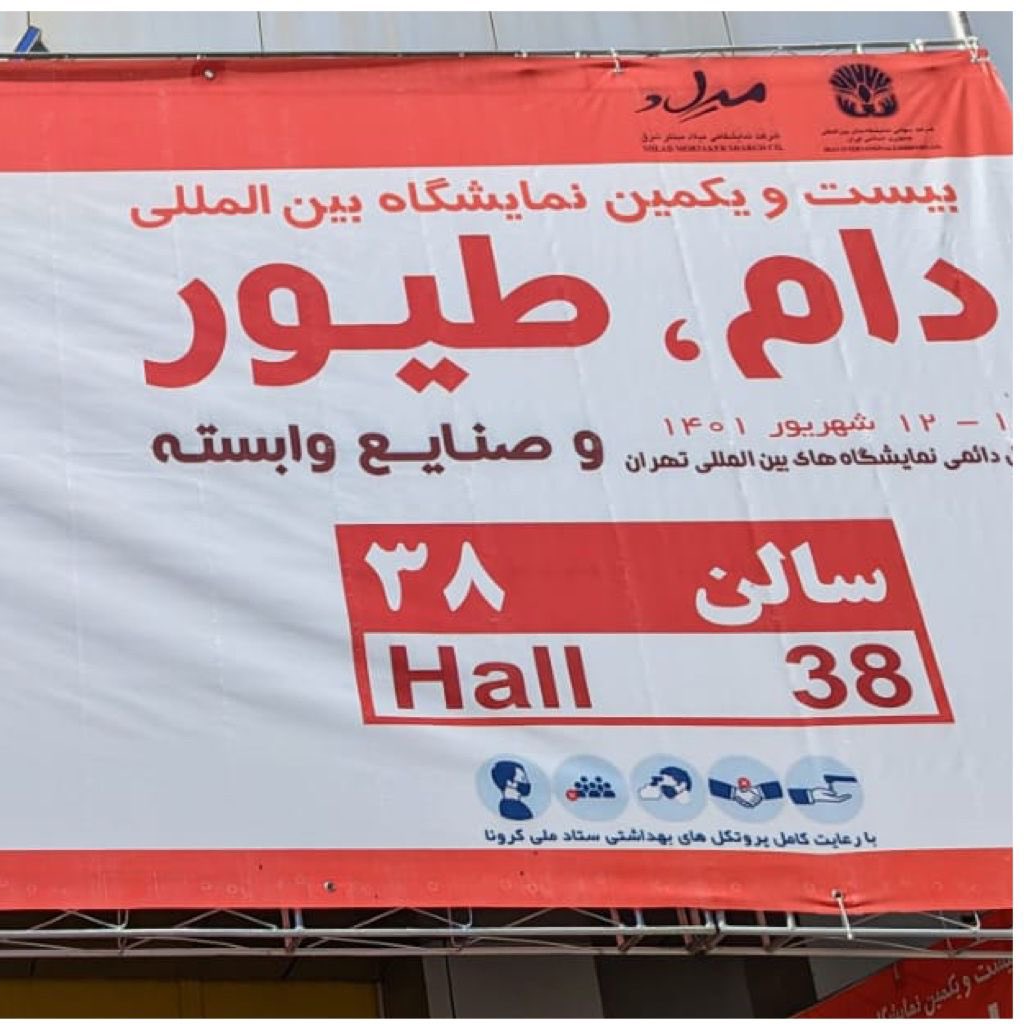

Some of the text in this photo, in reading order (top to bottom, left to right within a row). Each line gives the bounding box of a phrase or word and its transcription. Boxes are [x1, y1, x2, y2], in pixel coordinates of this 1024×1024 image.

[130, 176, 959, 232] بیست و یکمین نمایشگاه بین المللی
[144, 234, 613, 394] طیور
[663, 416, 746, 436] ۱۴۰۱
[768, 412, 876, 438] شهریور
[153, 424, 605, 477] و صنایع وابسته
[840, 445, 938, 472] نمایشگاه
[944, 446, 1002, 472] دائمی
[626, 452, 690, 474] تهران
[696, 452, 756, 475] المللی
[760, 454, 790, 473] بین
[365, 542, 888, 627] سالن ۳۸
[390, 643, 914, 712] Hall 38
[485, 829, 526, 847] کرونا
[530, 831, 559, 847] ملی
[564, 830, 602, 842] ستاد
[678, 832, 708, 847] های
[774, 833, 811, 849] کامل
